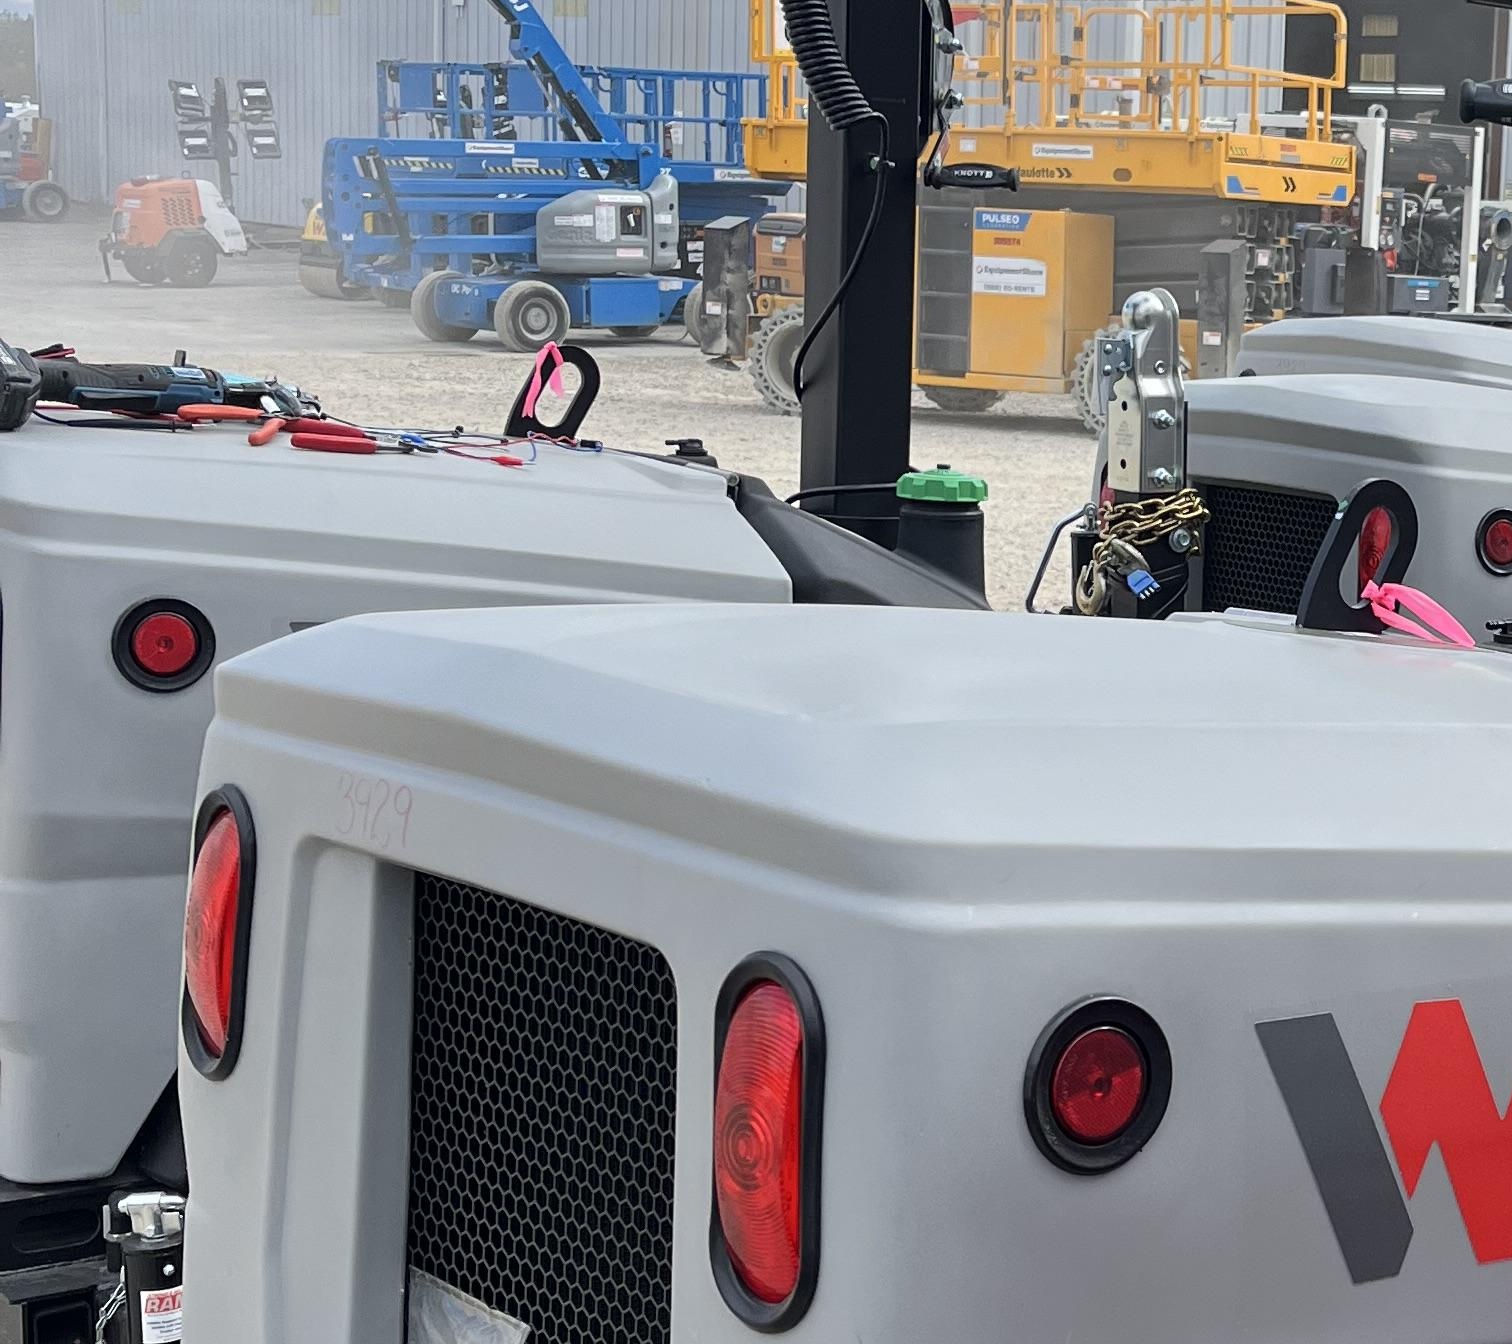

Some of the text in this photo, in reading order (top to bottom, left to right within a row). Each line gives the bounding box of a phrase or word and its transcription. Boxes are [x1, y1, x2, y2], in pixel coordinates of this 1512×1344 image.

[954, 169, 986, 178] KNOTT
[1017, 166, 1055, 179] aulotte
[982, 213, 1020, 225] PULSEO
[336, 771, 413, 849] 3929
